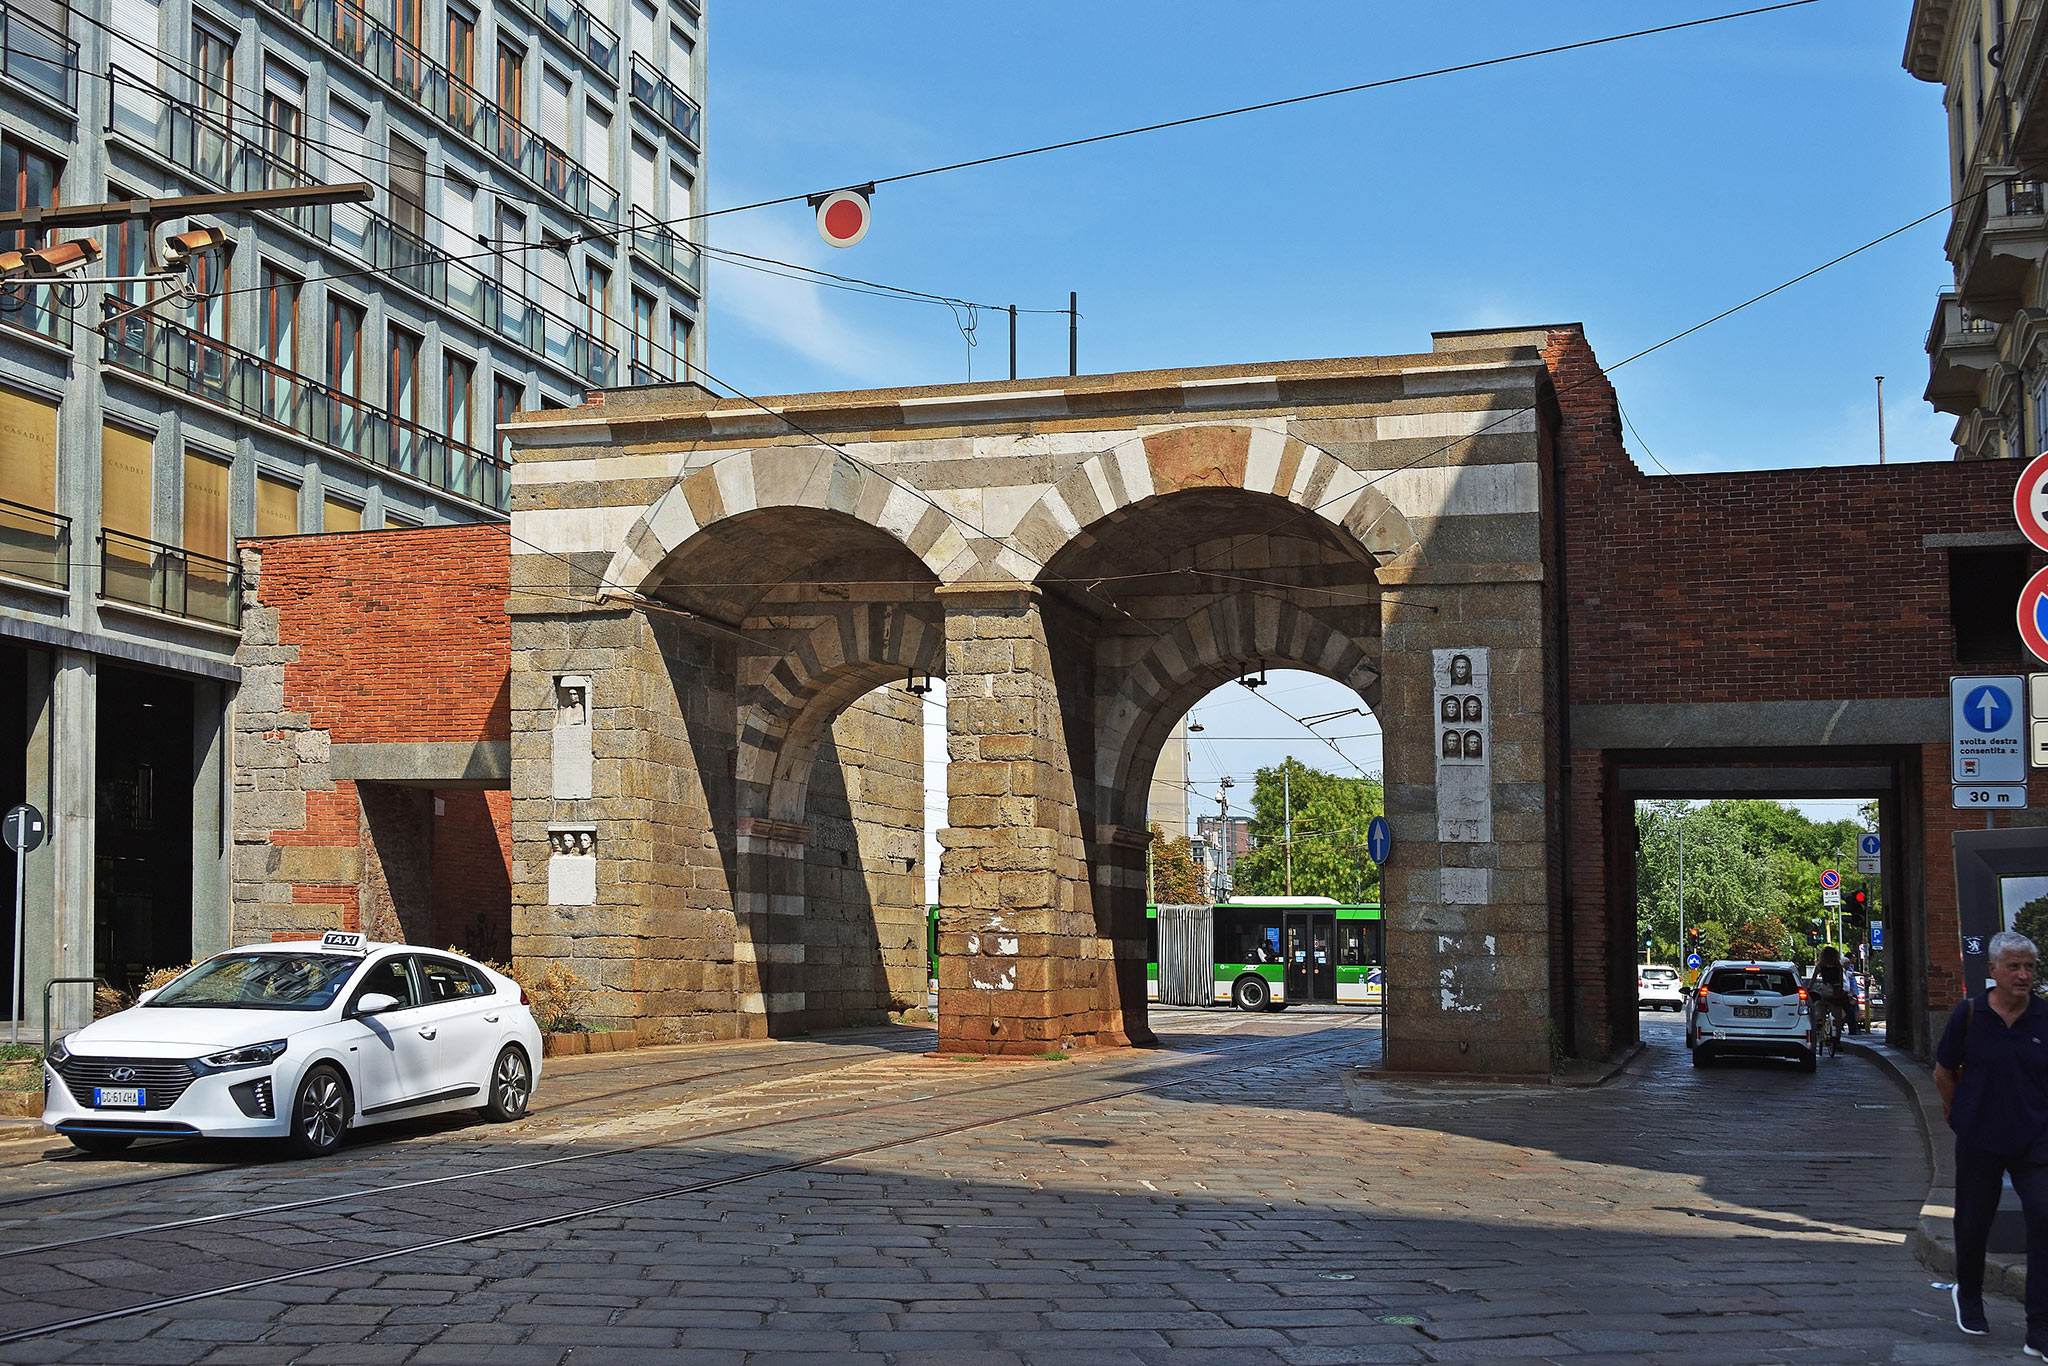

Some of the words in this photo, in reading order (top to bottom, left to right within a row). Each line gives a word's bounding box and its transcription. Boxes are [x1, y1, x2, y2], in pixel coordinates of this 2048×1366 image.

[3, 425, 45, 443] CASADEI
[108, 459, 144, 475] CASADEI
[188, 482, 220, 496] CASADEI
[260, 507, 291, 520] CASADEI
[1970, 791, 1990, 803] 30
[1997, 793, 2010, 803] m
[327, 935, 357, 945] TAXI
[1873, 929, 1880, 938] P
